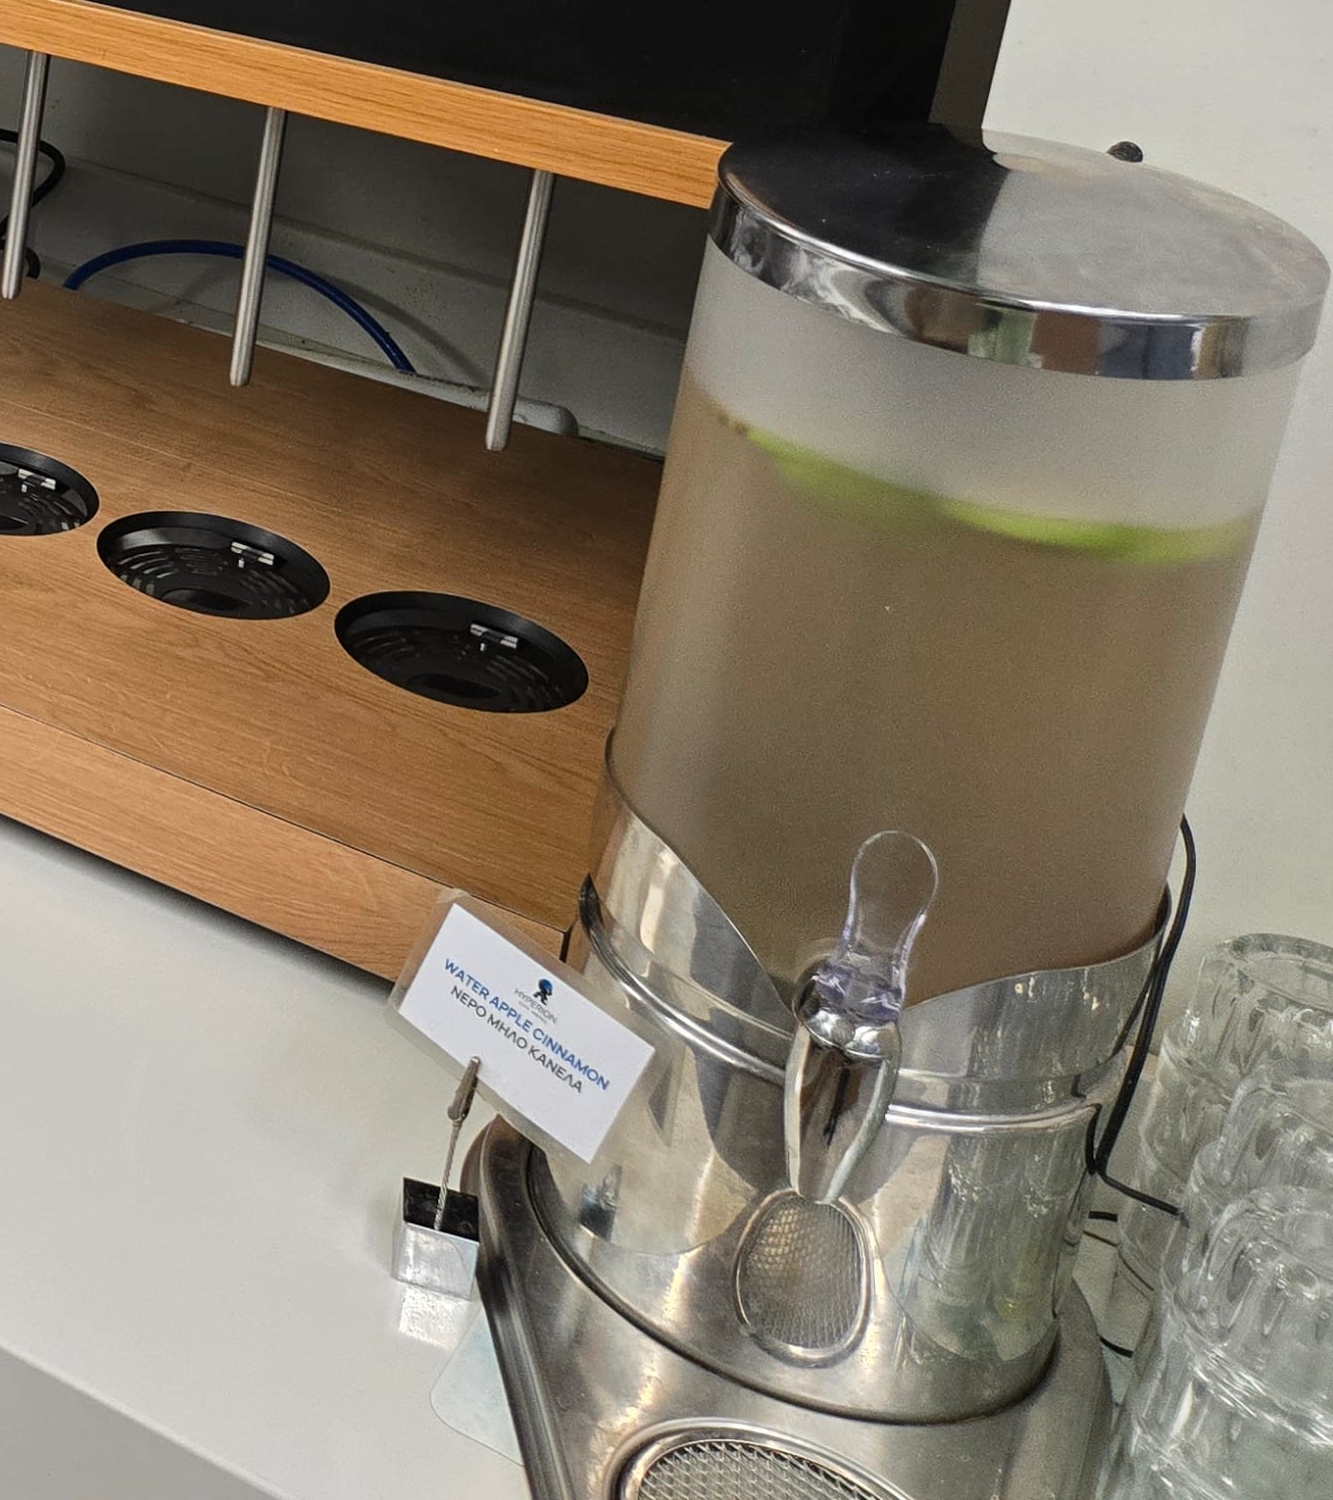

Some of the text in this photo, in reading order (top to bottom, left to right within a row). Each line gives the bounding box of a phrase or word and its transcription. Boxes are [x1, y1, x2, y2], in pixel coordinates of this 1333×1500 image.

[444, 958, 491, 1001] WATER
[488, 995, 533, 1034] APPLE
[532, 1027, 611, 1091] CINNAMON
[450, 984, 488, 1020] ΝΕΡΟ
[486, 1013, 529, 1050] ΜΗΛΟ
[527, 1045, 584, 1094] ΚΑΝΕΛΑ
